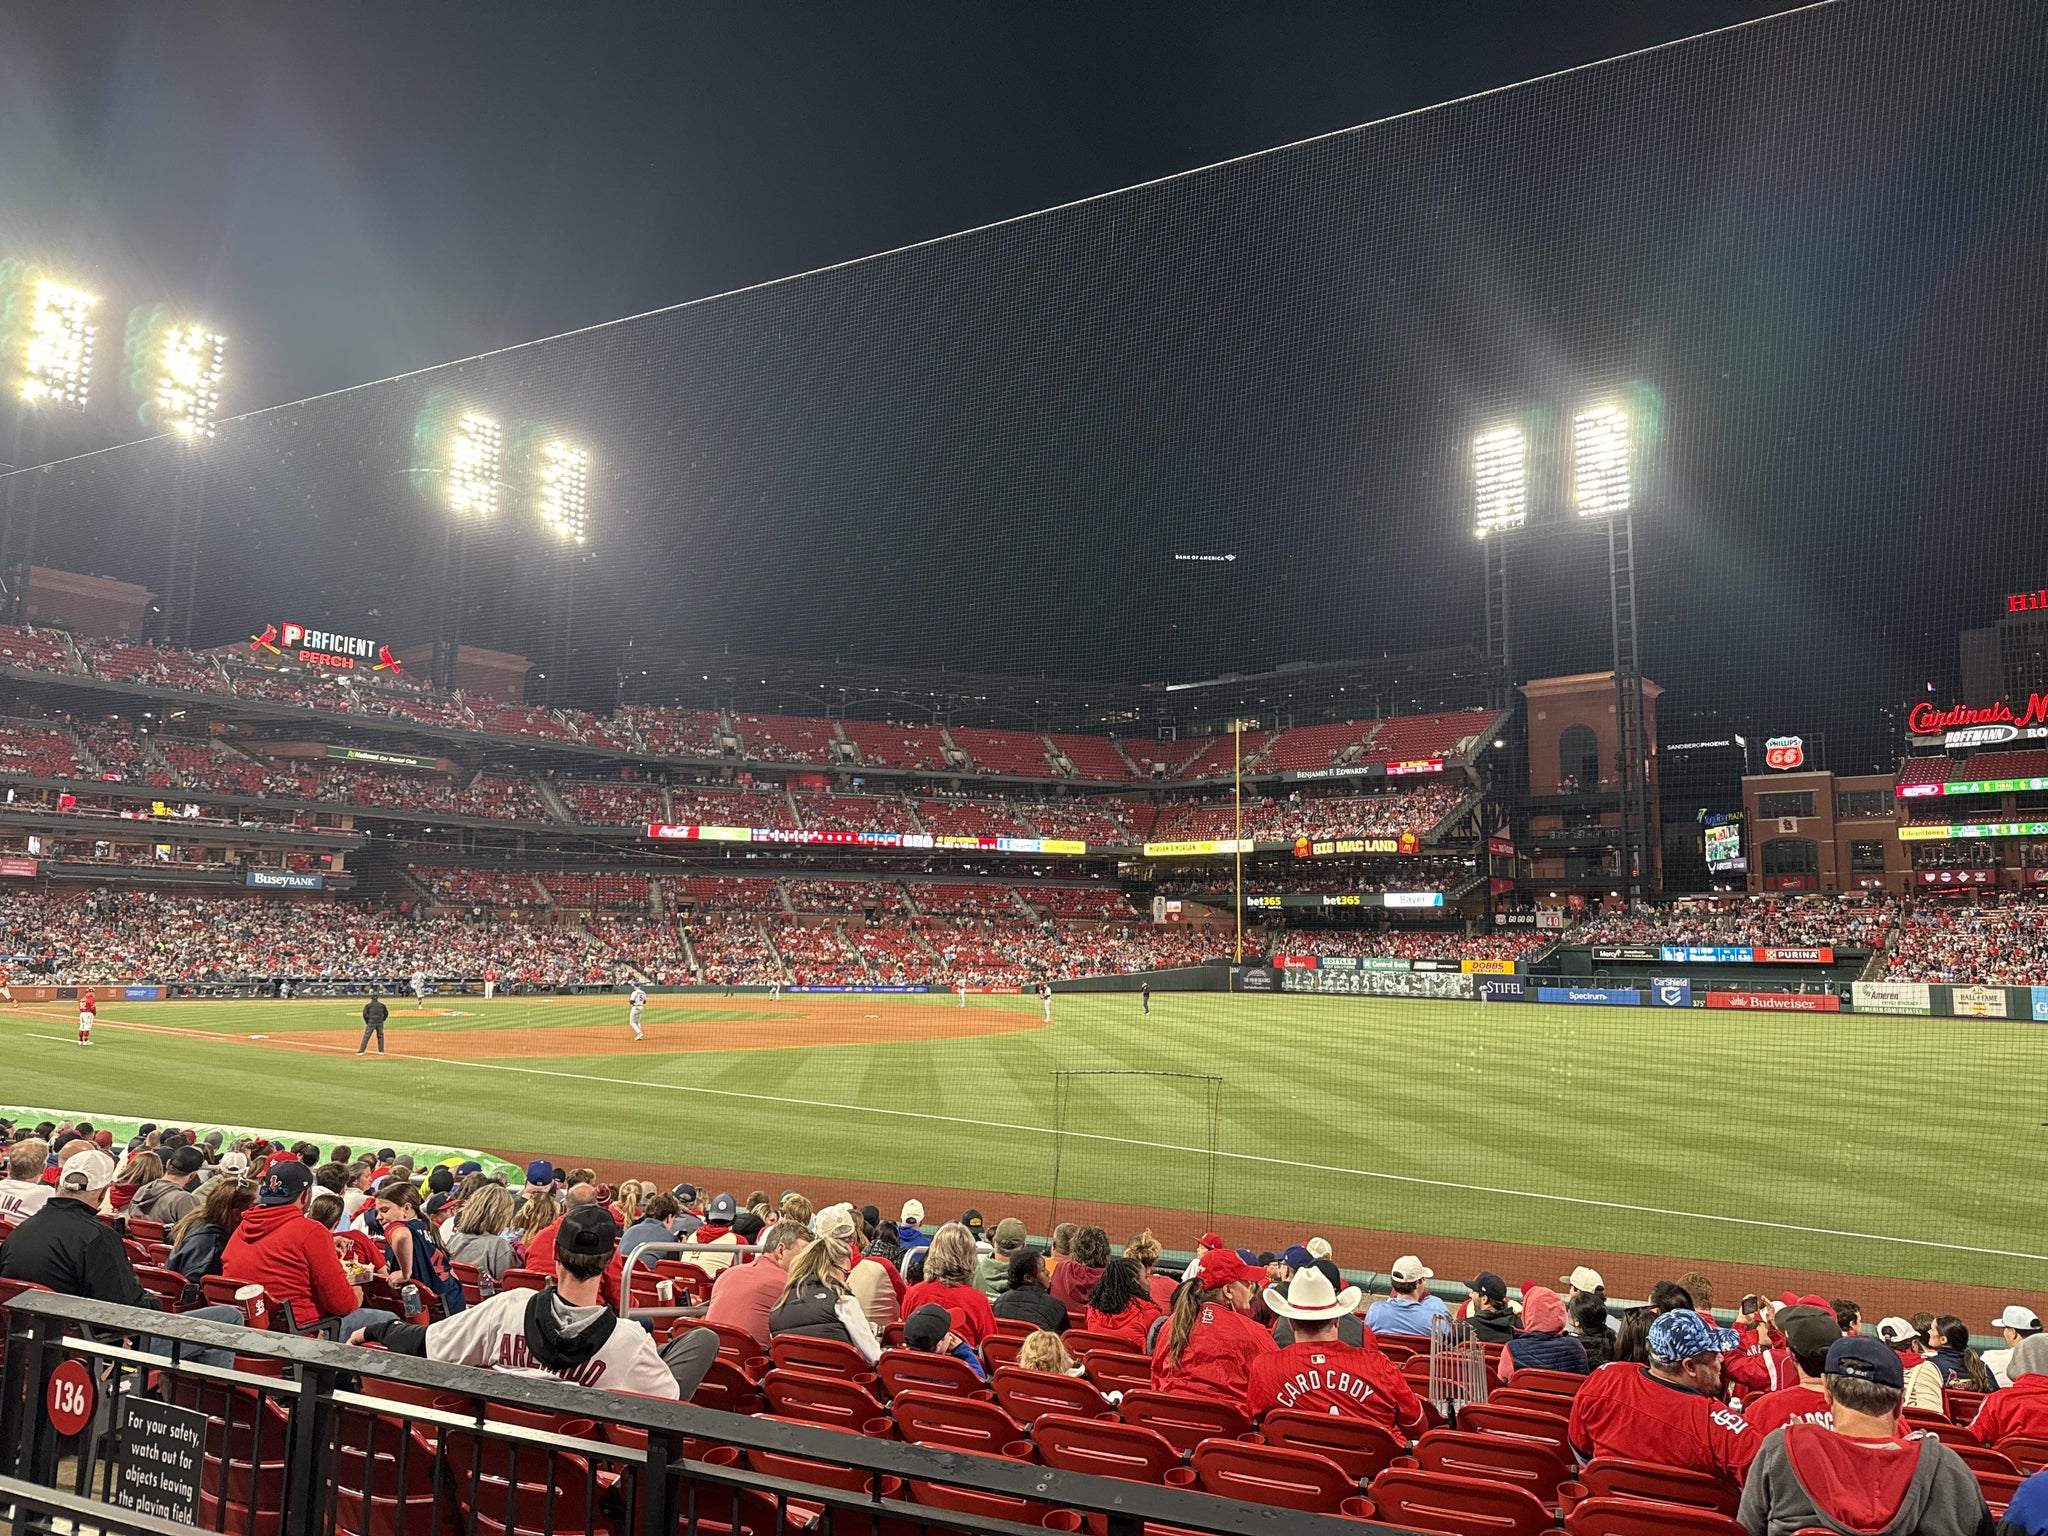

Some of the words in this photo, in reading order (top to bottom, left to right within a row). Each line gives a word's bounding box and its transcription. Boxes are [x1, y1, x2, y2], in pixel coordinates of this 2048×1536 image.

[2007, 589, 2048, 613] Hil
[281, 621, 376, 658] PERFICIENT
[299, 650, 354, 669] PERCH
[1908, 701, 2014, 735] Cardinals
[1768, 738, 1798, 748] PHILLIPS
[1945, 728, 2005, 743] HOFFMANN
[355, 751, 379, 761] National
[1771, 748, 1797, 764] 66
[1296, 768, 1328, 779] BENJAMIN
[1336, 766, 1369, 776] EDWARDS
[1313, 842, 1335, 855] BIG
[1336, 840, 1364, 853] MAC
[1365, 840, 1398, 852] LAND
[1247, 896, 1281, 906] bet365
[1323, 895, 1360, 905] bet365
[1508, 915, 1516, 923] GO
[1517, 915, 1525, 923] GO
[1526, 915, 1534, 923] GO
[1600, 950, 1616, 958] Mercy
[1778, 951, 1817, 959] PURINA
[1472, 962, 1504, 970] DOBBS
[1486, 980, 1524, 995] STIFEL
[1653, 978, 1688, 987] CarShield
[1569, 991, 1604, 1000] Spectrum
[1871, 991, 1899, 1000] Ameren
[1981, 994, 1998, 1002] FAME
[0, 1194, 23, 1214] INA
[54, 1378, 85, 1416] 136
[128, 1411, 143, 1430] For
[146, 1420, 167, 1436] your
[170, 1422, 199, 1449] safety,
[131, 1442, 159, 1460] watch
[161, 1450, 177, 1465] out
[179, 1450, 193, 1470] for
[125, 1463, 158, 1487] objects
[160, 1472, 193, 1503] leaving
[118, 1489, 134, 1507] the
[135, 1493, 170, 1520] playing
[172, 1502, 195, 1526] field.
